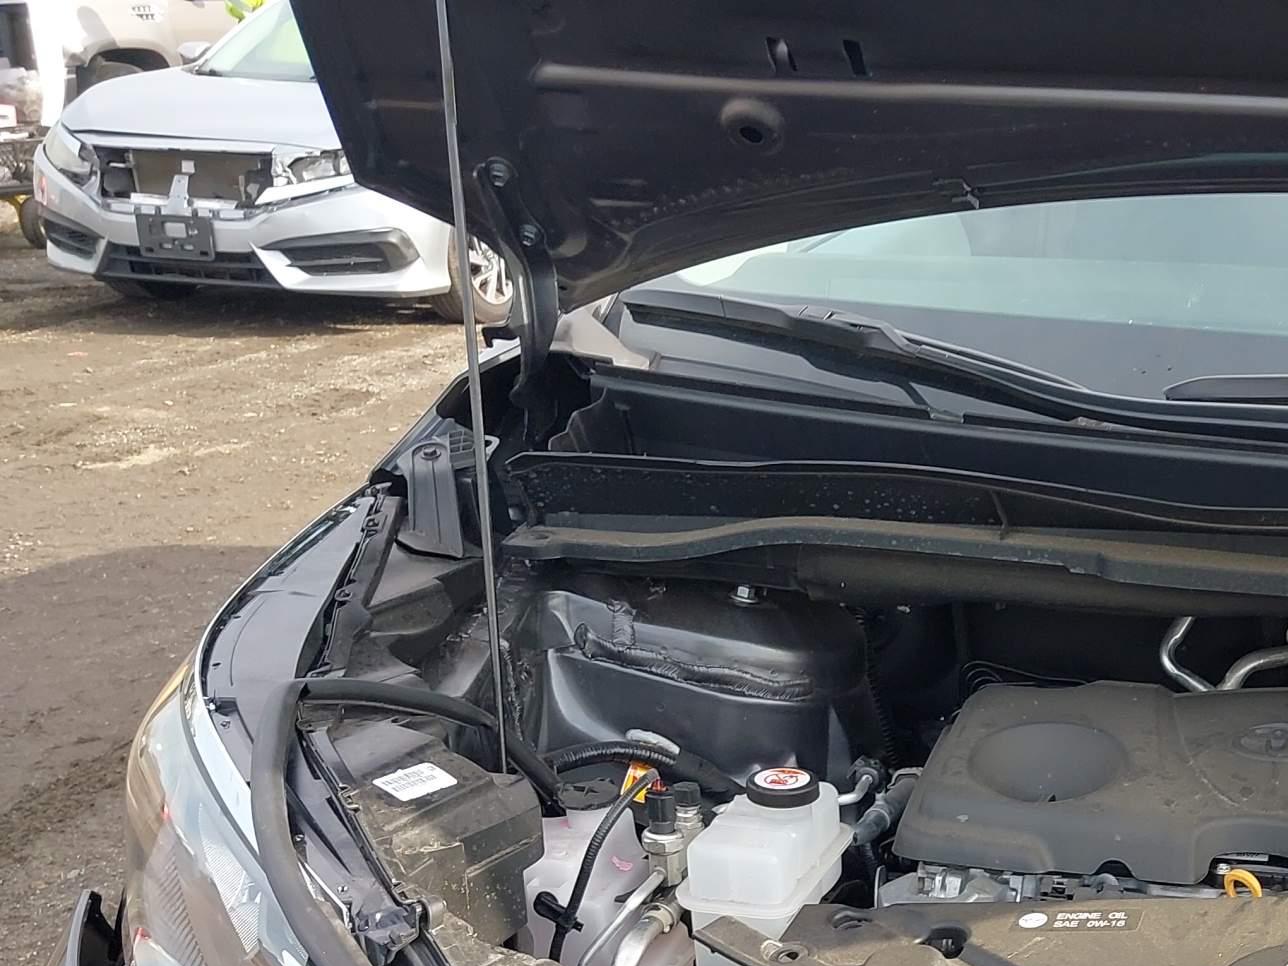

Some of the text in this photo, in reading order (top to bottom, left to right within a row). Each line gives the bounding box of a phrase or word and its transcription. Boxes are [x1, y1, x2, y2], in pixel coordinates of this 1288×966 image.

[1056, 911, 1128, 920] ENGINE OIL
[1053, 919, 1126, 928] SAE 0W-16
